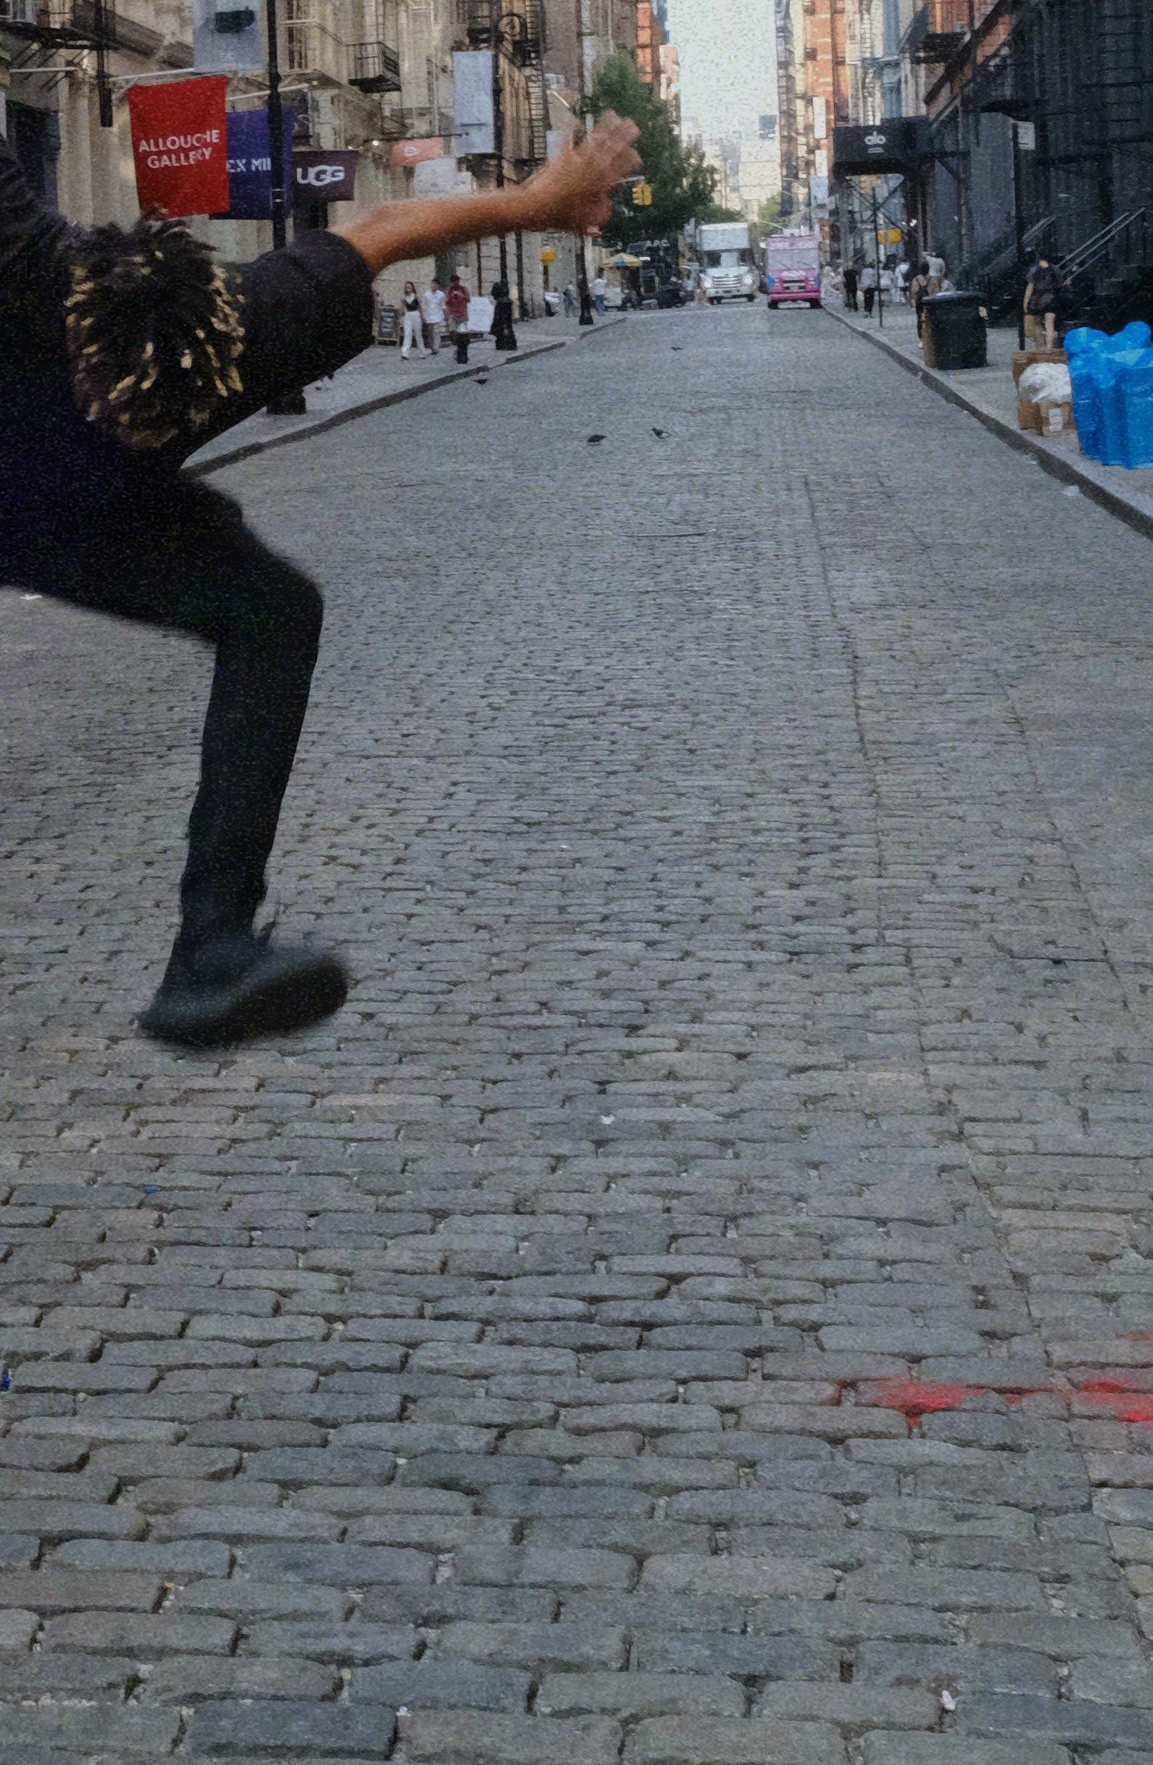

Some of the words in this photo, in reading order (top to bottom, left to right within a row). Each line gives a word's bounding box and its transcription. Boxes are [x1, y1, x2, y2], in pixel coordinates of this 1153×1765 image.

[138, 129, 220, 153] ALLOUCHE
[147, 147, 213, 169] GALLERY
[296, 164, 345, 187] UGG
